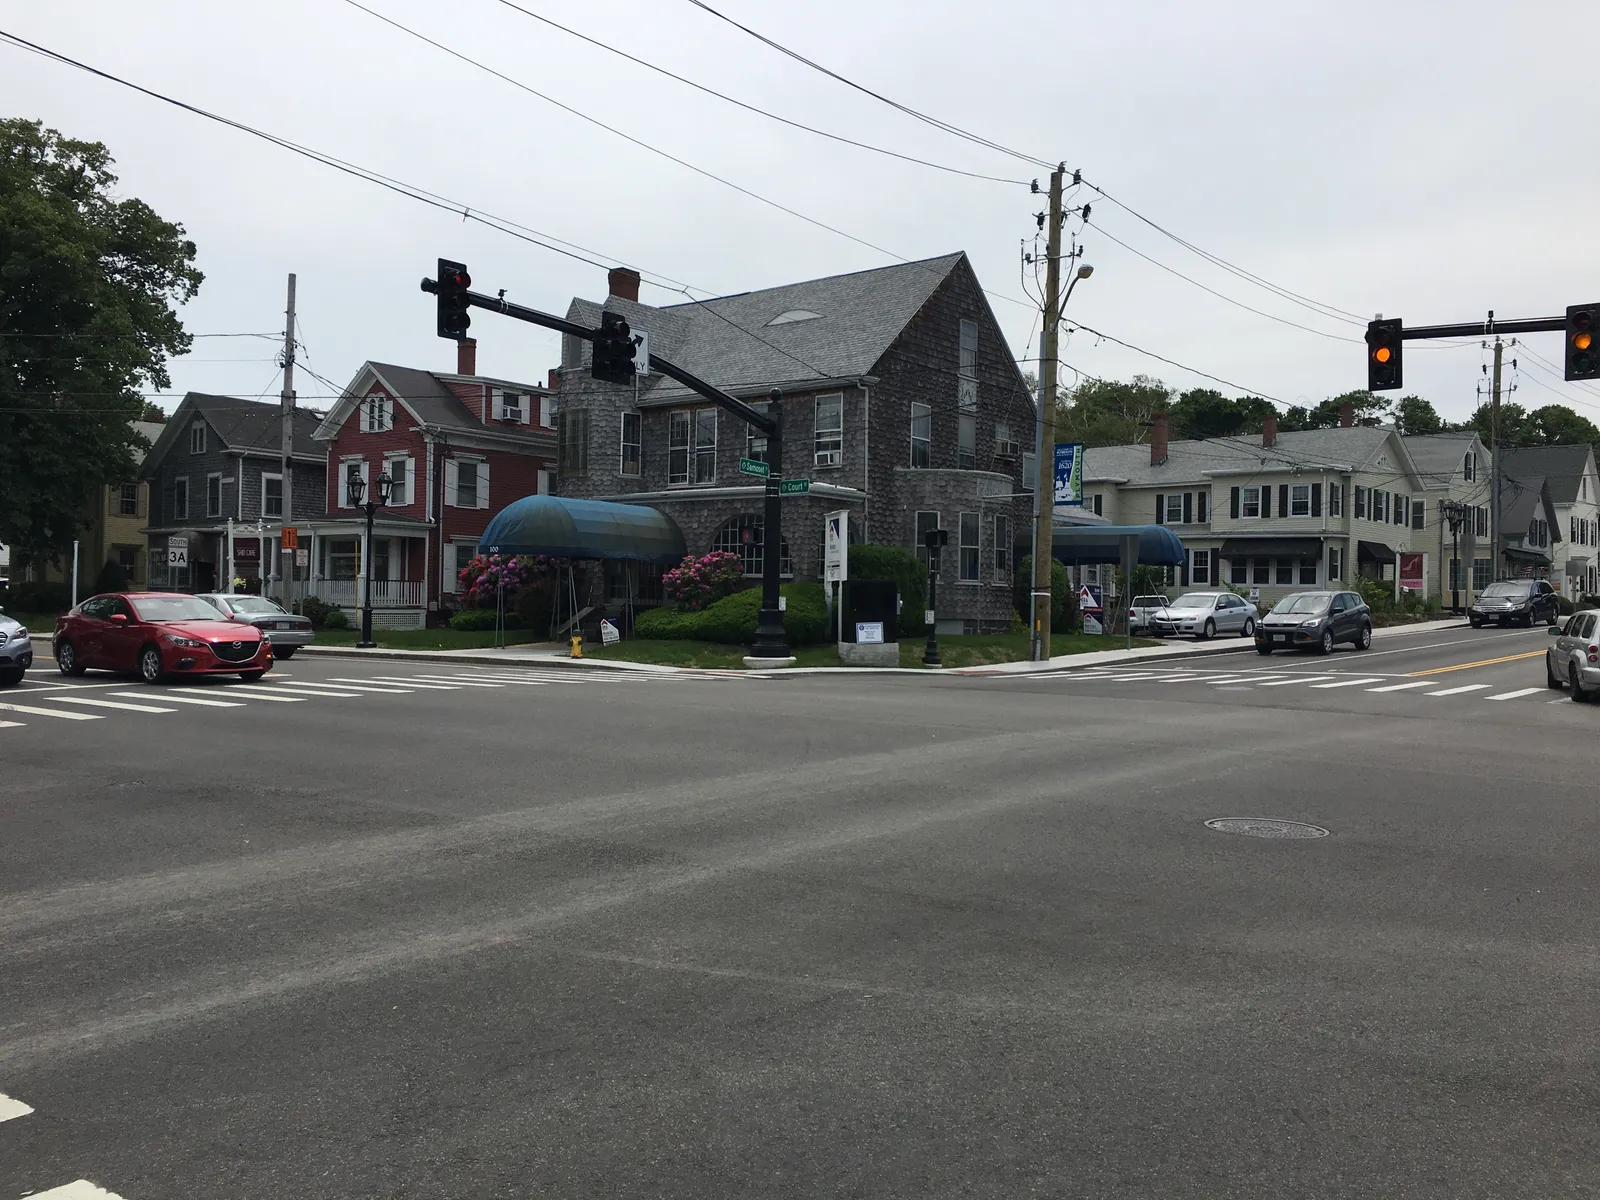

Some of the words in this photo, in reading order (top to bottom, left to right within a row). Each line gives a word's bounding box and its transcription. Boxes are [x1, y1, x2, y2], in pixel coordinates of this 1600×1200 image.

[746, 462, 765, 473] Samoset
[787, 482, 803, 491] Court
[169, 538, 187, 546] SOUTH
[169, 551, 186, 563] 3A
